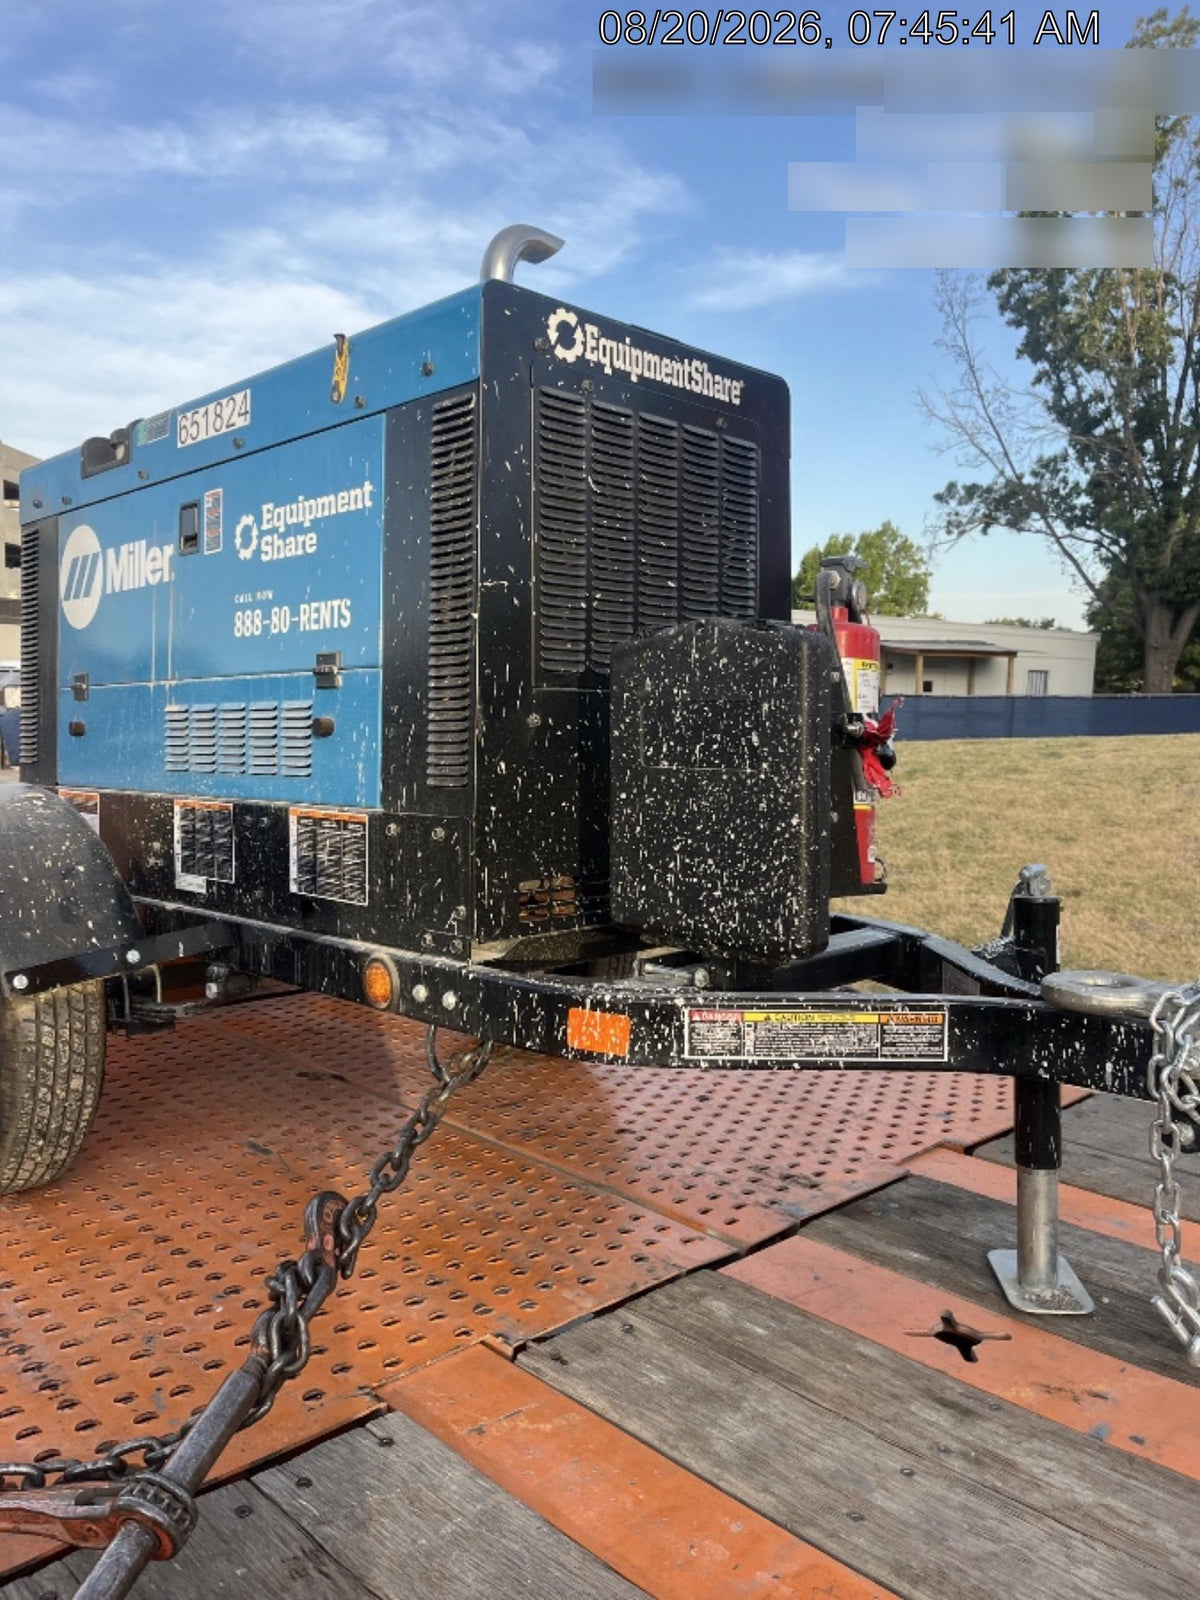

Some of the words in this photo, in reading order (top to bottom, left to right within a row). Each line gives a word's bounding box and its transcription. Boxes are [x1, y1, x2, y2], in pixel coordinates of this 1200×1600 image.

[584, 322, 742, 406] EquipmentShare
[178, 390, 249, 445] 651824
[261, 480, 374, 534] Equipment
[260, 531, 317, 563] Share
[233, 598, 352, 638] 888-80-RENTS
